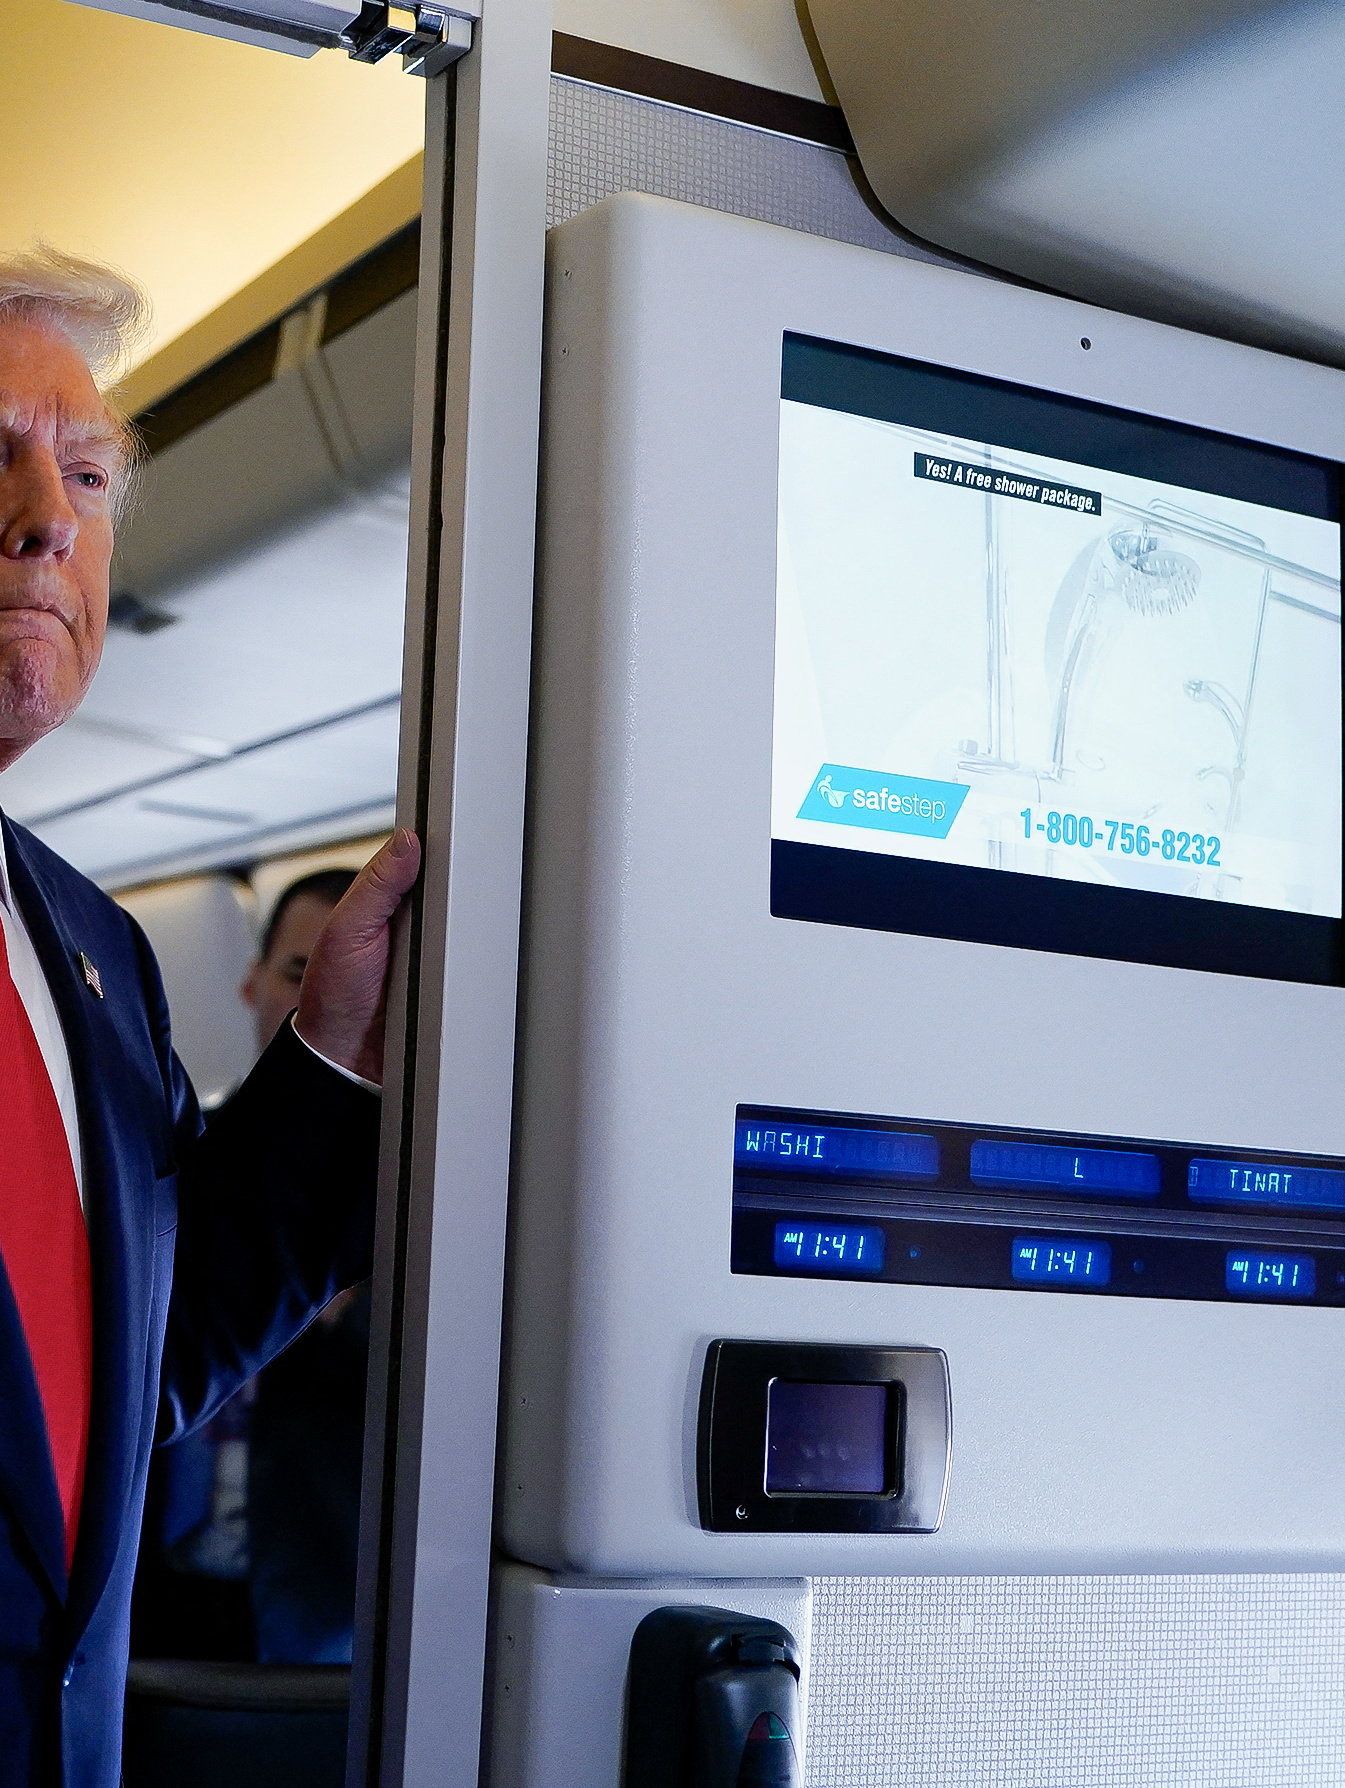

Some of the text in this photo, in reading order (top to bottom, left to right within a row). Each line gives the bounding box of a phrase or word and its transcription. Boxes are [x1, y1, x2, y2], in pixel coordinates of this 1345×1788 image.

[925, 458, 1096, 511] Yes! A free shower package.
[853, 787, 946, 823] safestep
[1020, 808, 1221, 867] 1-800-756-8232
[746, 1131, 825, 1158] WASHI
[1074, 1158, 1084, 1178] L
[1230, 1169, 1292, 1193] TINAT
[796, 1232, 864, 1259] 11:41
[1031, 1247, 1092, 1274] 11:41
[1242, 1260, 1299, 1286] 11:41
